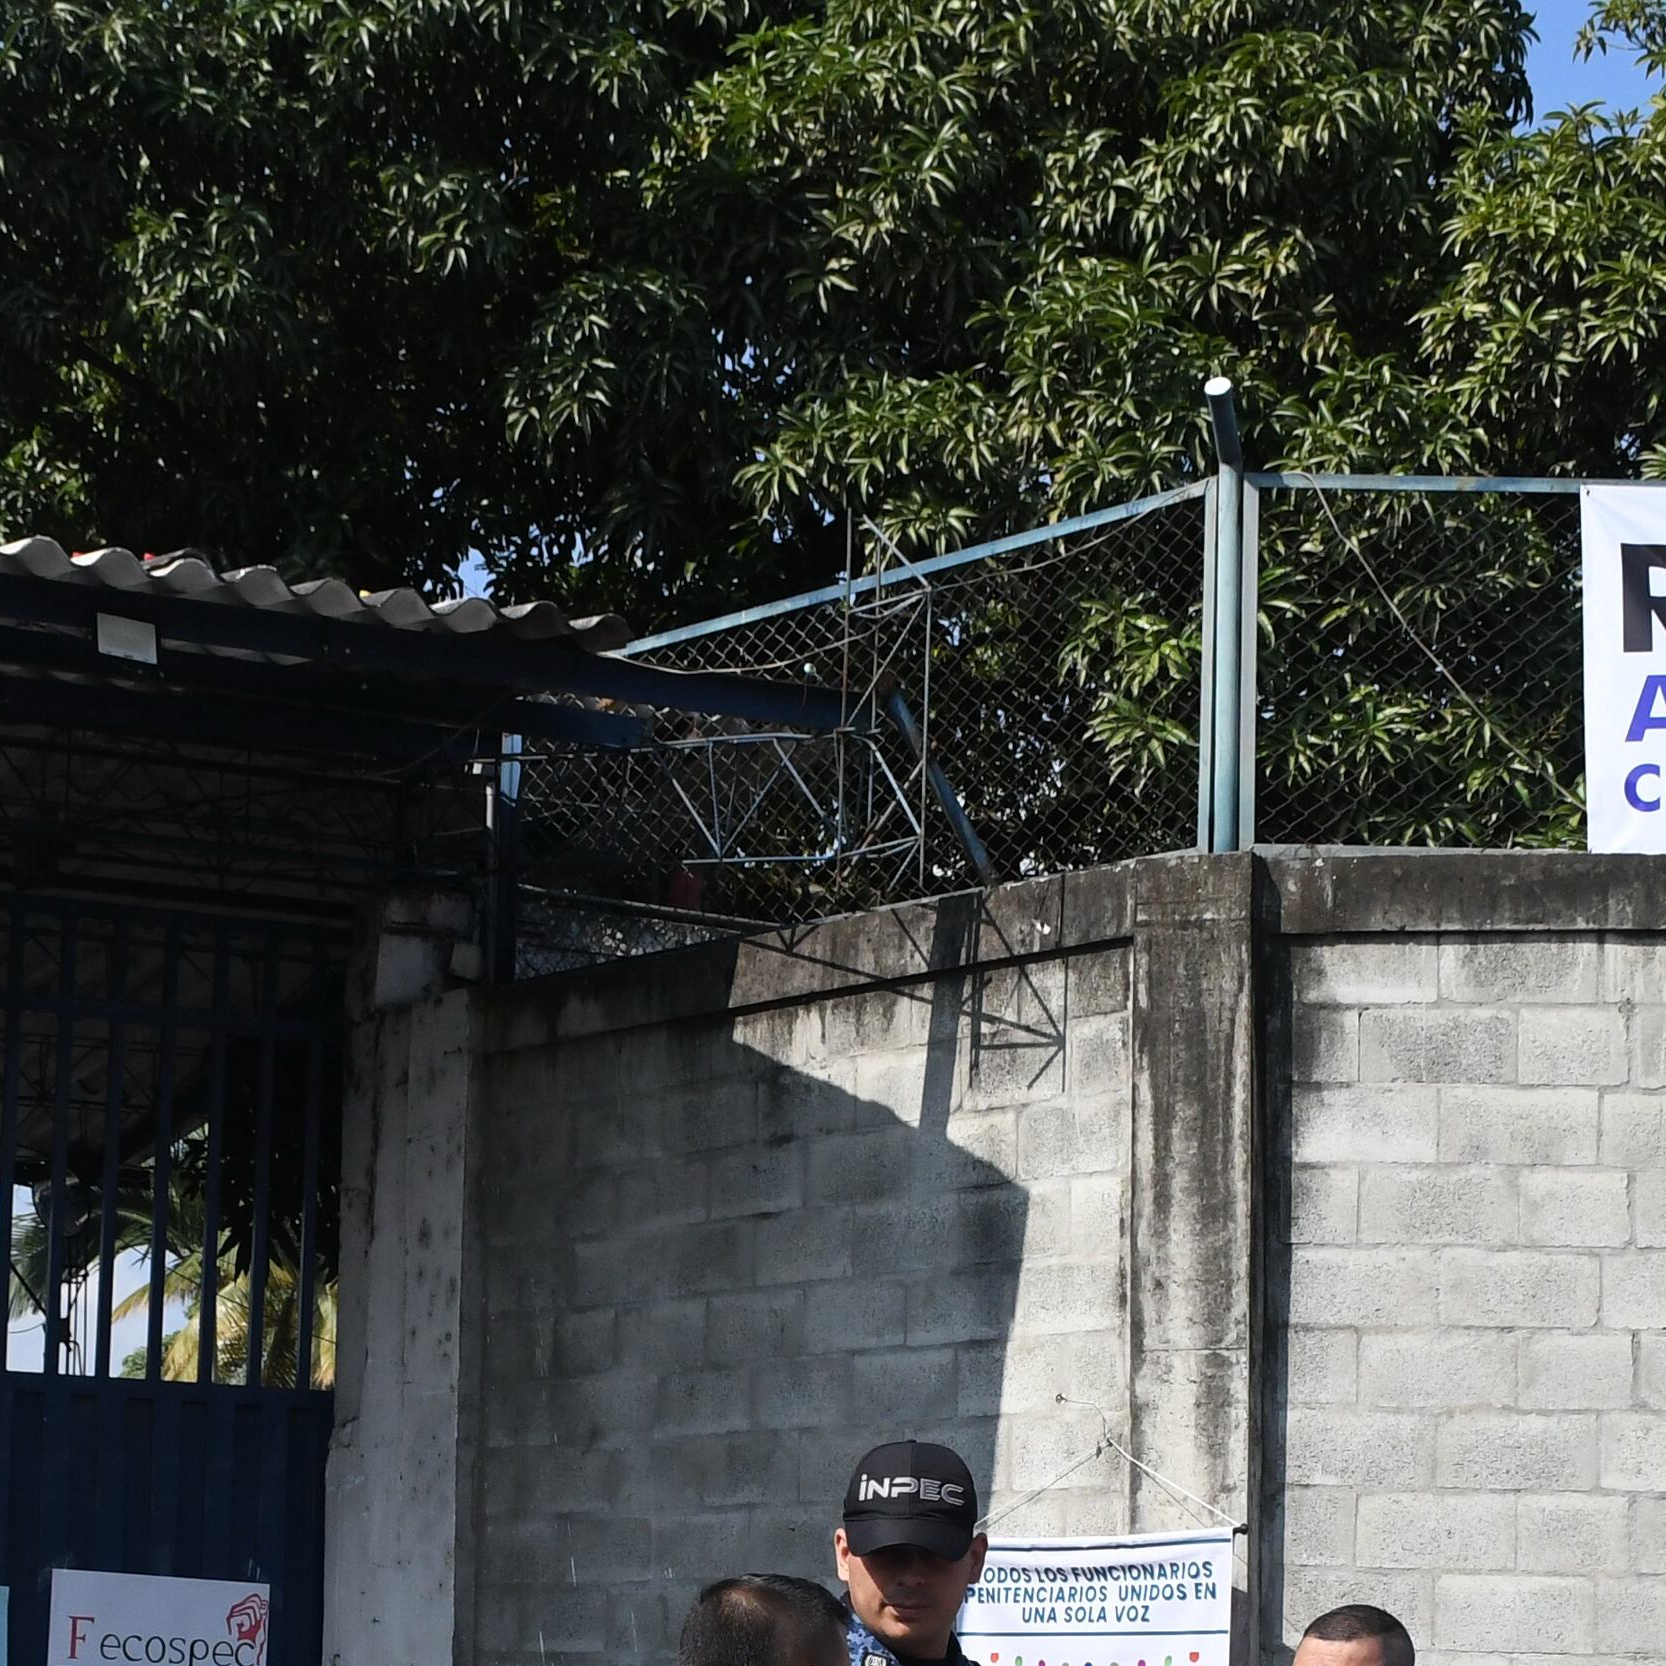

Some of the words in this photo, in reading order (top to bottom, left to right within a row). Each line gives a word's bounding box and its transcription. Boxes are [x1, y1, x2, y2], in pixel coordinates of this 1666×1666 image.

[984, 1566, 1032, 1584] ODOS
[1037, 1566, 1069, 1583] LOS
[1073, 1561, 1213, 1583] FUNCIONARIOS
[965, 1585, 1108, 1604] PENITENCIARIOS
[1118, 1582, 1188, 1602] UNIDOS
[1194, 1582, 1217, 1600] EN
[1021, 1606, 1057, 1624] UNA
[1064, 1606, 1108, 1624] SOLA
[1115, 1605, 1151, 1623] VOZ
